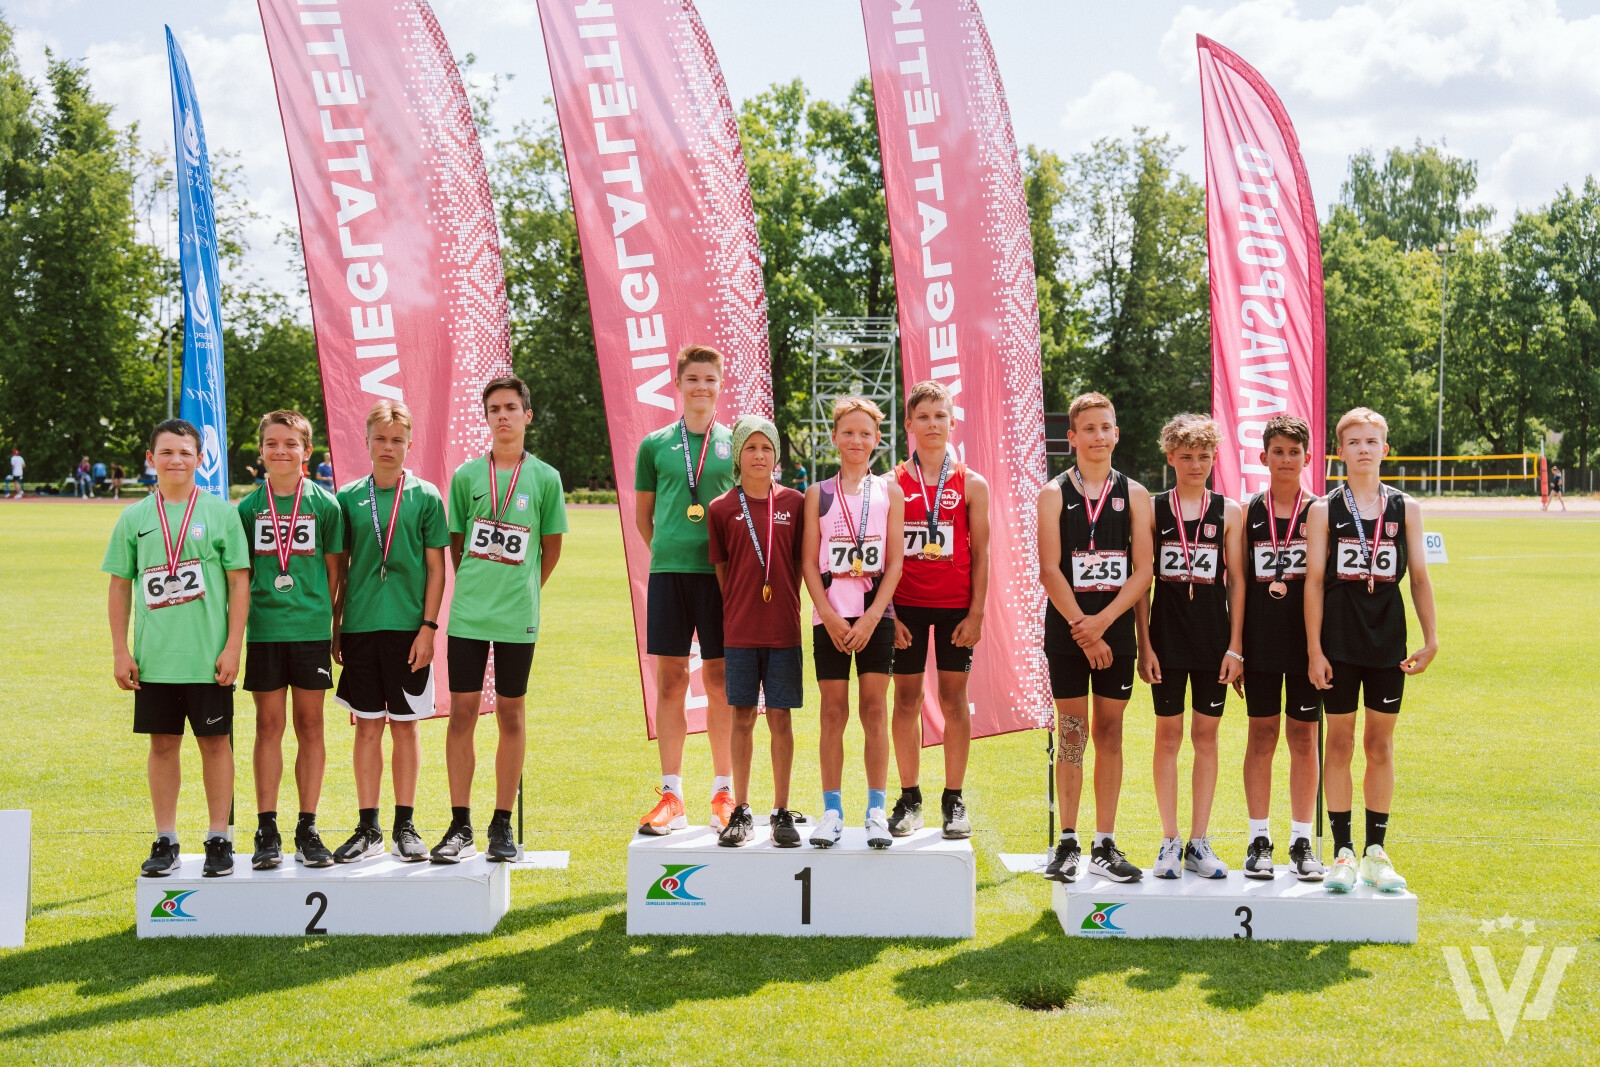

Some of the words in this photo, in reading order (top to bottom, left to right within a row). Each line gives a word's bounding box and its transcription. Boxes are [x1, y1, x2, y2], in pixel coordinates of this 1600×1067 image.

[1426, 535, 1442, 548] 60
[832, 547, 879, 566] 708
[1164, 551, 1212, 572] 224
[1261, 549, 1307, 570] 252
[1078, 561, 1122, 580] 235
[794, 867, 811, 924] 1
[305, 891, 327, 935] 2
[1234, 906, 1252, 939] 3
